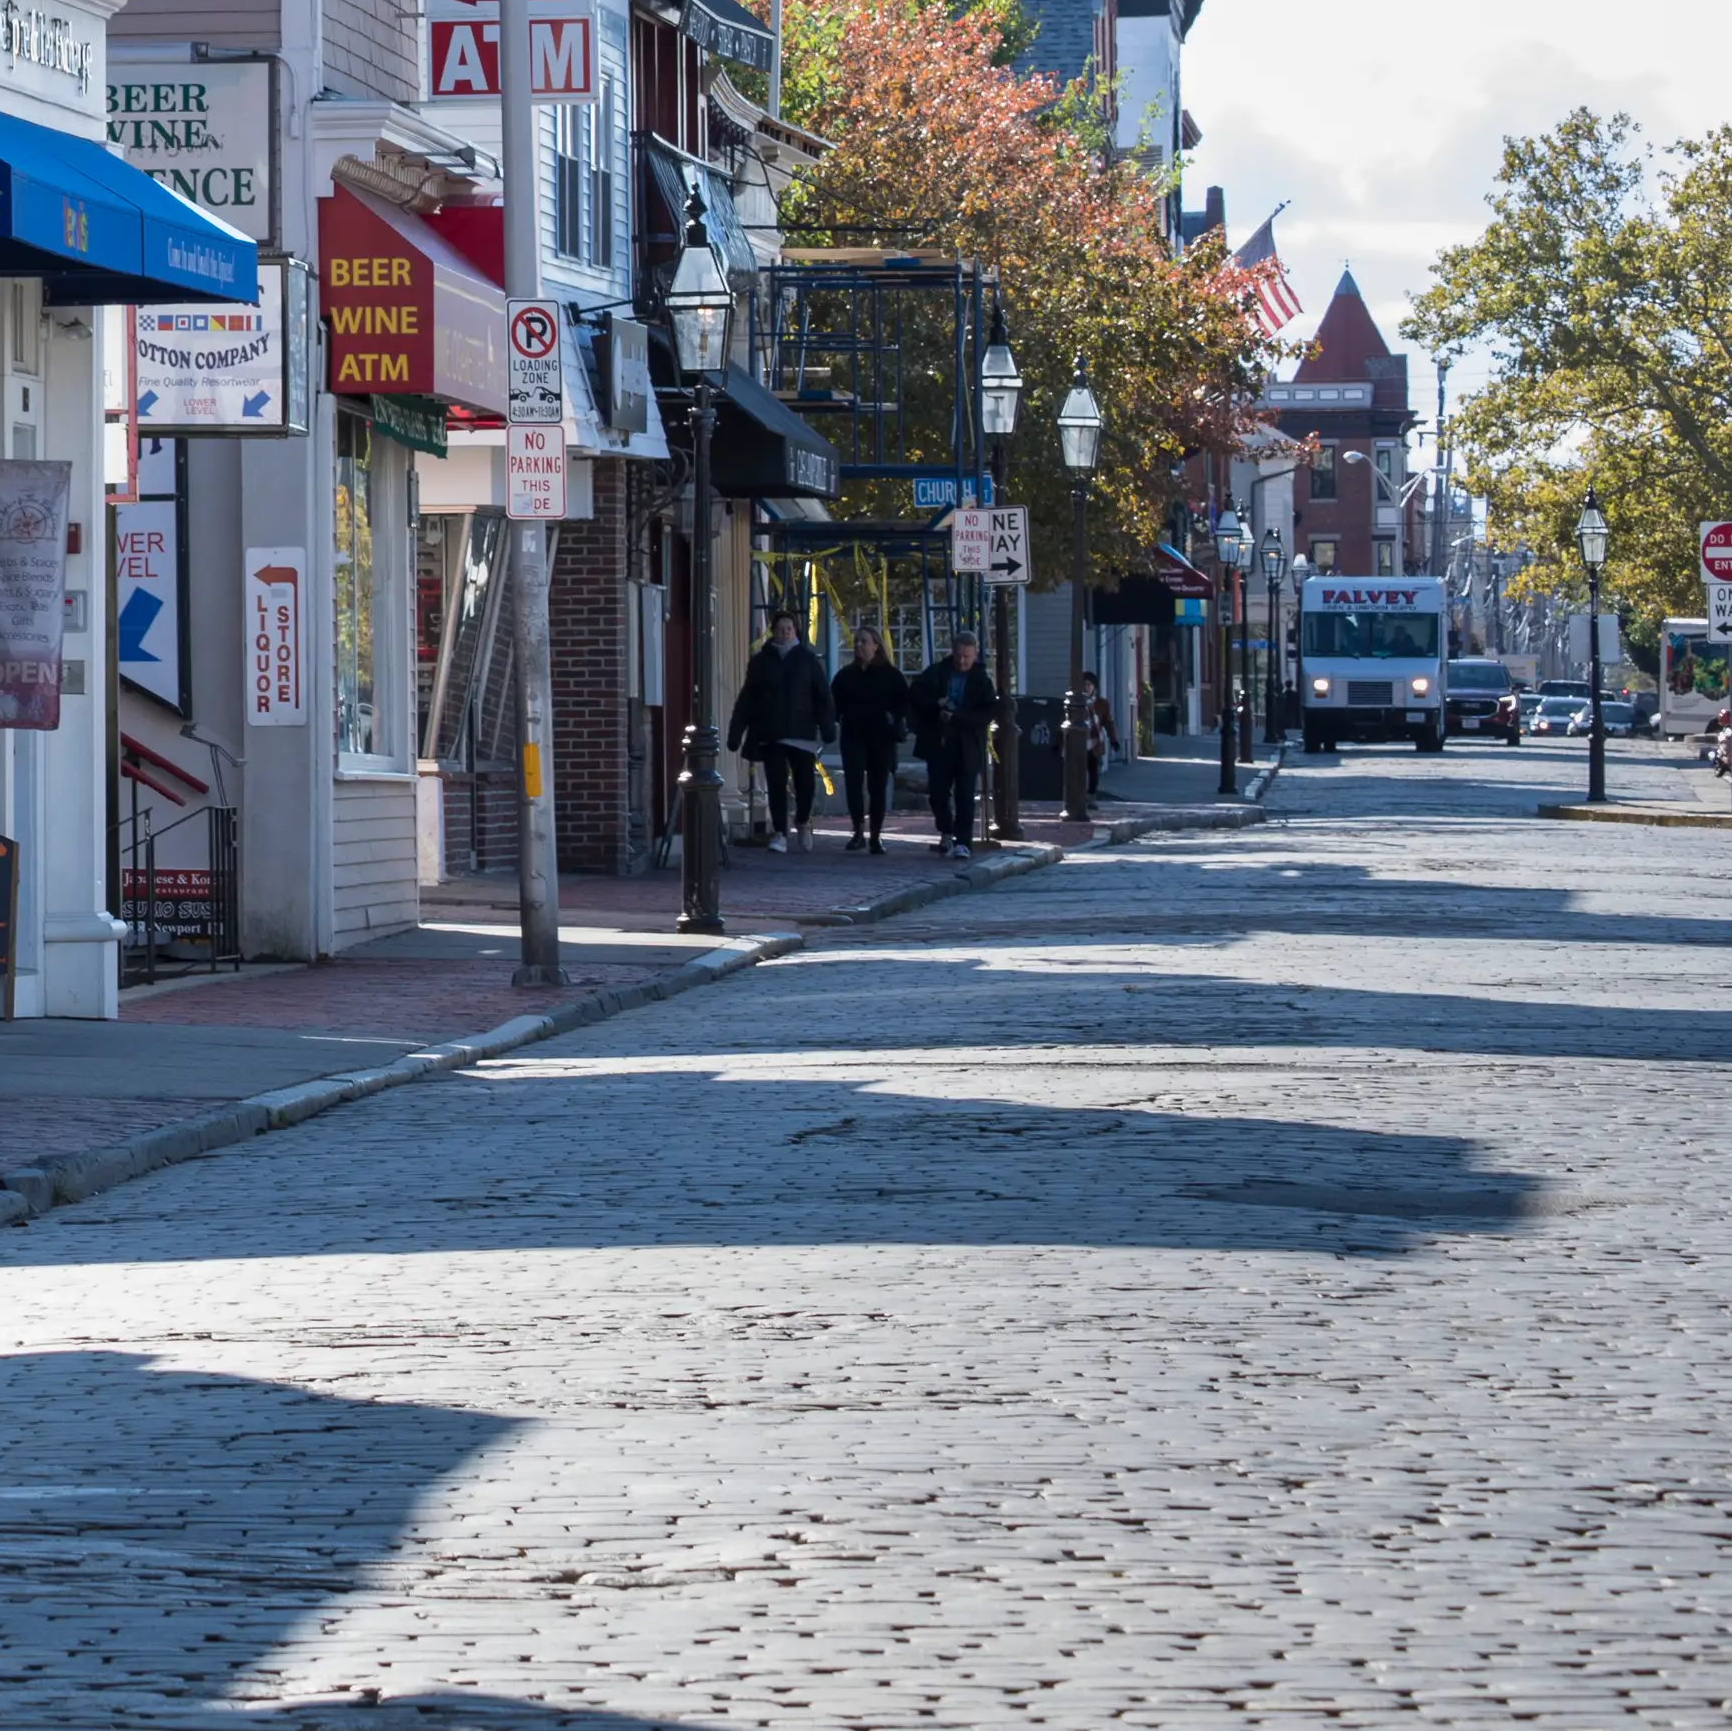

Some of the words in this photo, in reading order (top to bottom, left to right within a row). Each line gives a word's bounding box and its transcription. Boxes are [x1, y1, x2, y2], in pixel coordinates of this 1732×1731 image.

[330, 258, 412, 286] BEER
[330, 306, 419, 334] WINE
[137, 339, 191, 369] OTTON
[195, 333, 270, 369] COMPANY
[338, 354, 409, 381] ATM
[513, 360, 558, 372] LOADING
[139, 377, 160, 387] Fine
[163, 377, 197, 388] Quality
[201, 377, 260, 387] Resortwear
[522, 372, 549, 384] ZONE
[183, 398, 217, 407] LOWER
[185, 406, 215, 415] LEVEL
[525, 433, 545, 450] NO
[511, 456, 561, 474] PARKING
[522, 480, 550, 491] THIS
[965, 515, 978, 526] NO
[992, 513, 1019, 531] NE
[957, 530, 988, 542] PARKING
[1710, 534, 1725, 544] DO
[963, 545, 981, 553] THIS
[991, 534, 1021, 553] AY
[1322, 590, 1419, 605] FALVEY
[11, 615, 34, 627] Gifts
[255, 595, 270, 713] LIQUOR
[276, 605, 291, 702] STORE
